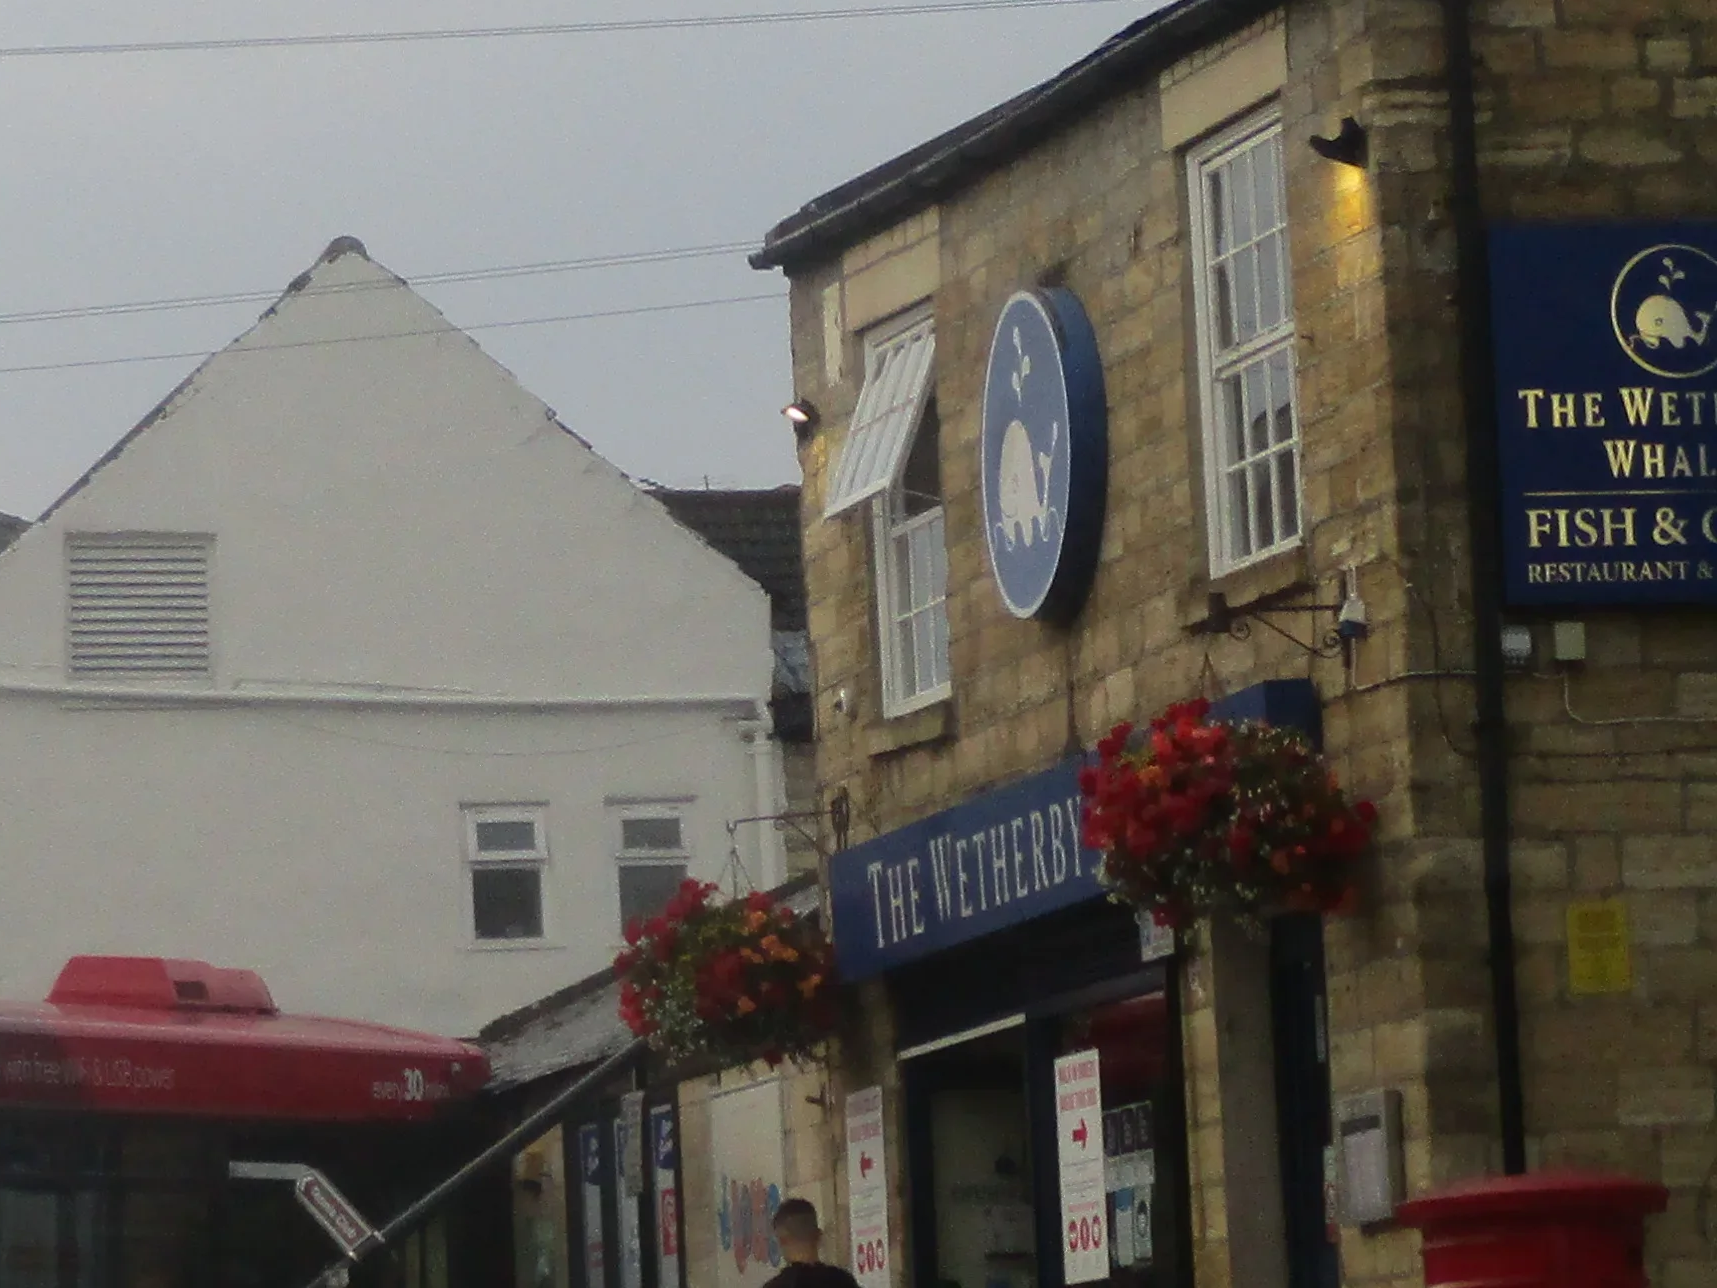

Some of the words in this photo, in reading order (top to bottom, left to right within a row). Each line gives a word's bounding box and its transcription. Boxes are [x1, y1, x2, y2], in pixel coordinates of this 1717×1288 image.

[1518, 388, 1606, 429] THE
[1619, 386, 1717, 428] WET
[1526, 507, 1638, 548] FISH
[1652, 506, 1689, 546] &
[1527, 560, 1688, 584] RESTAURANT
[868, 855, 926, 950] THE
[928, 794, 1085, 923] WETHERBY
[403, 1067, 425, 1102] 30
